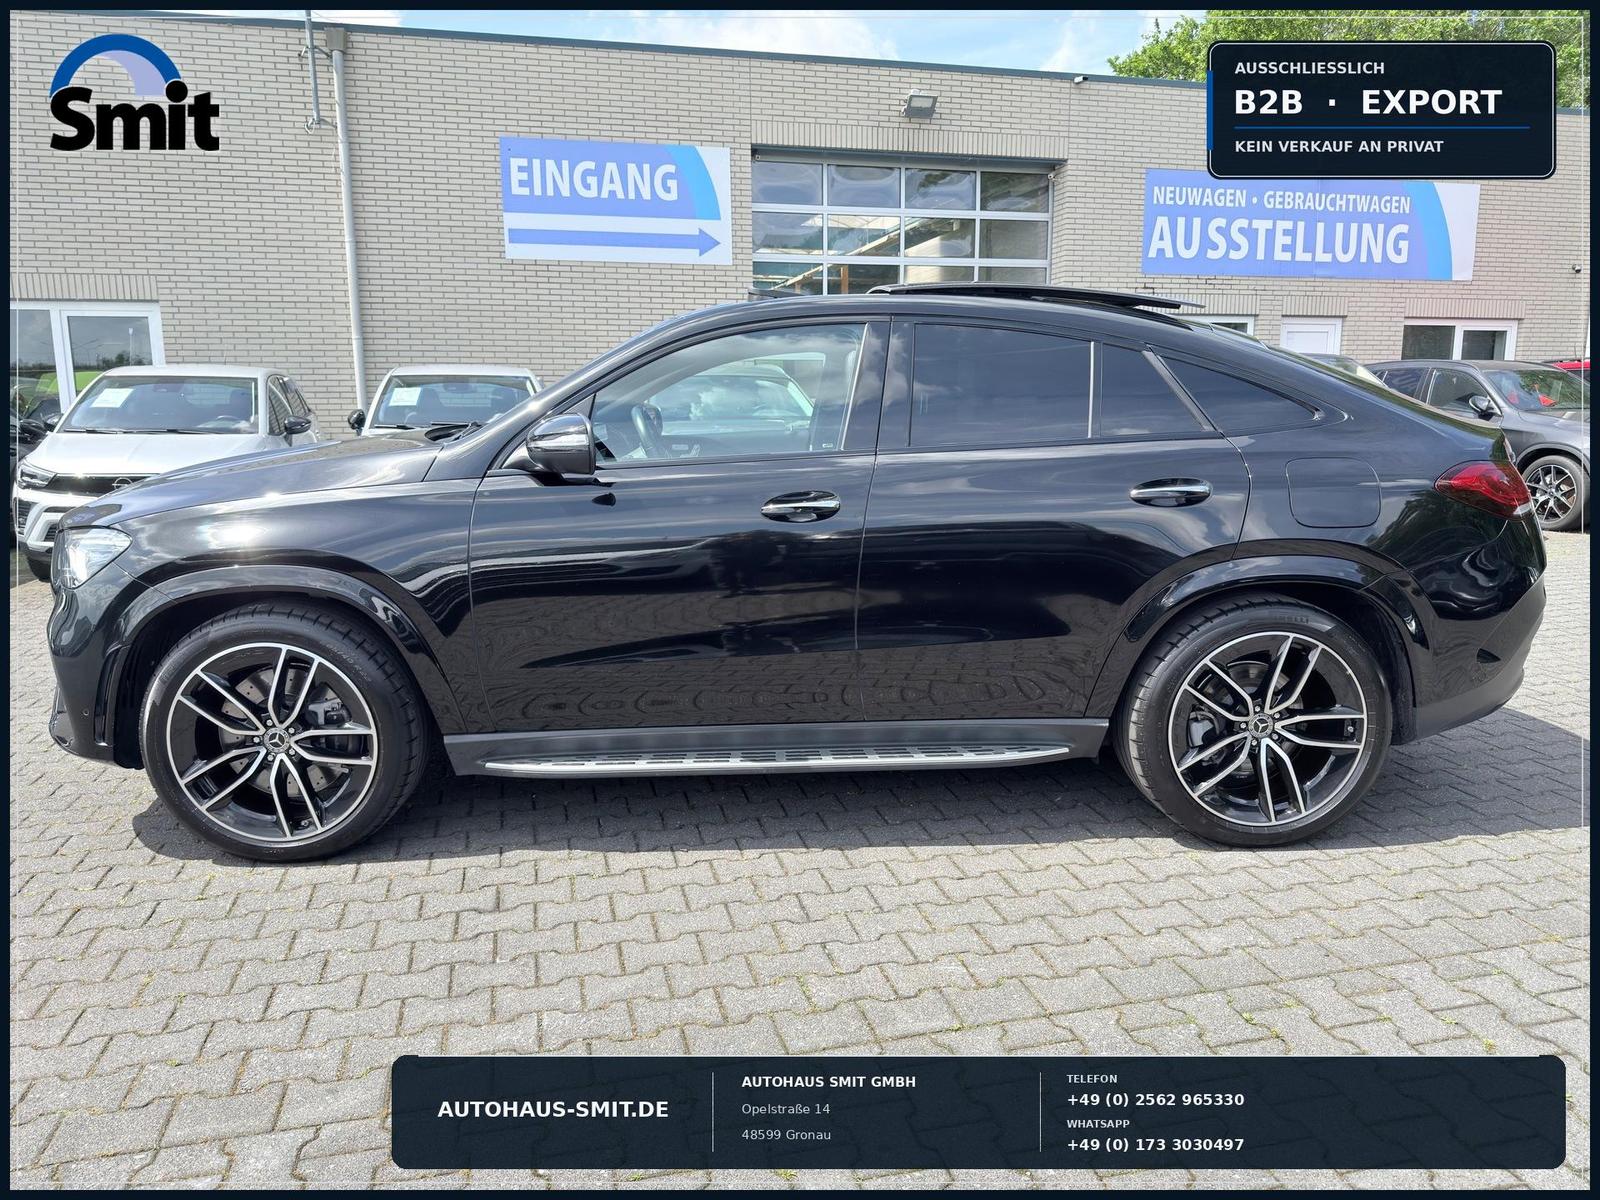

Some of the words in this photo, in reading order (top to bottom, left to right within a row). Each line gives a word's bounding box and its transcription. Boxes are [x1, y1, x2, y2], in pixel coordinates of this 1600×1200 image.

[510, 157, 679, 202] EINGANG
[1153, 186, 1247, 208] NEUWAGEN
[1263, 190, 1411, 214] GEBRAUCHTWAGEN
[1148, 215, 1410, 264] AUSSTELLUNG
